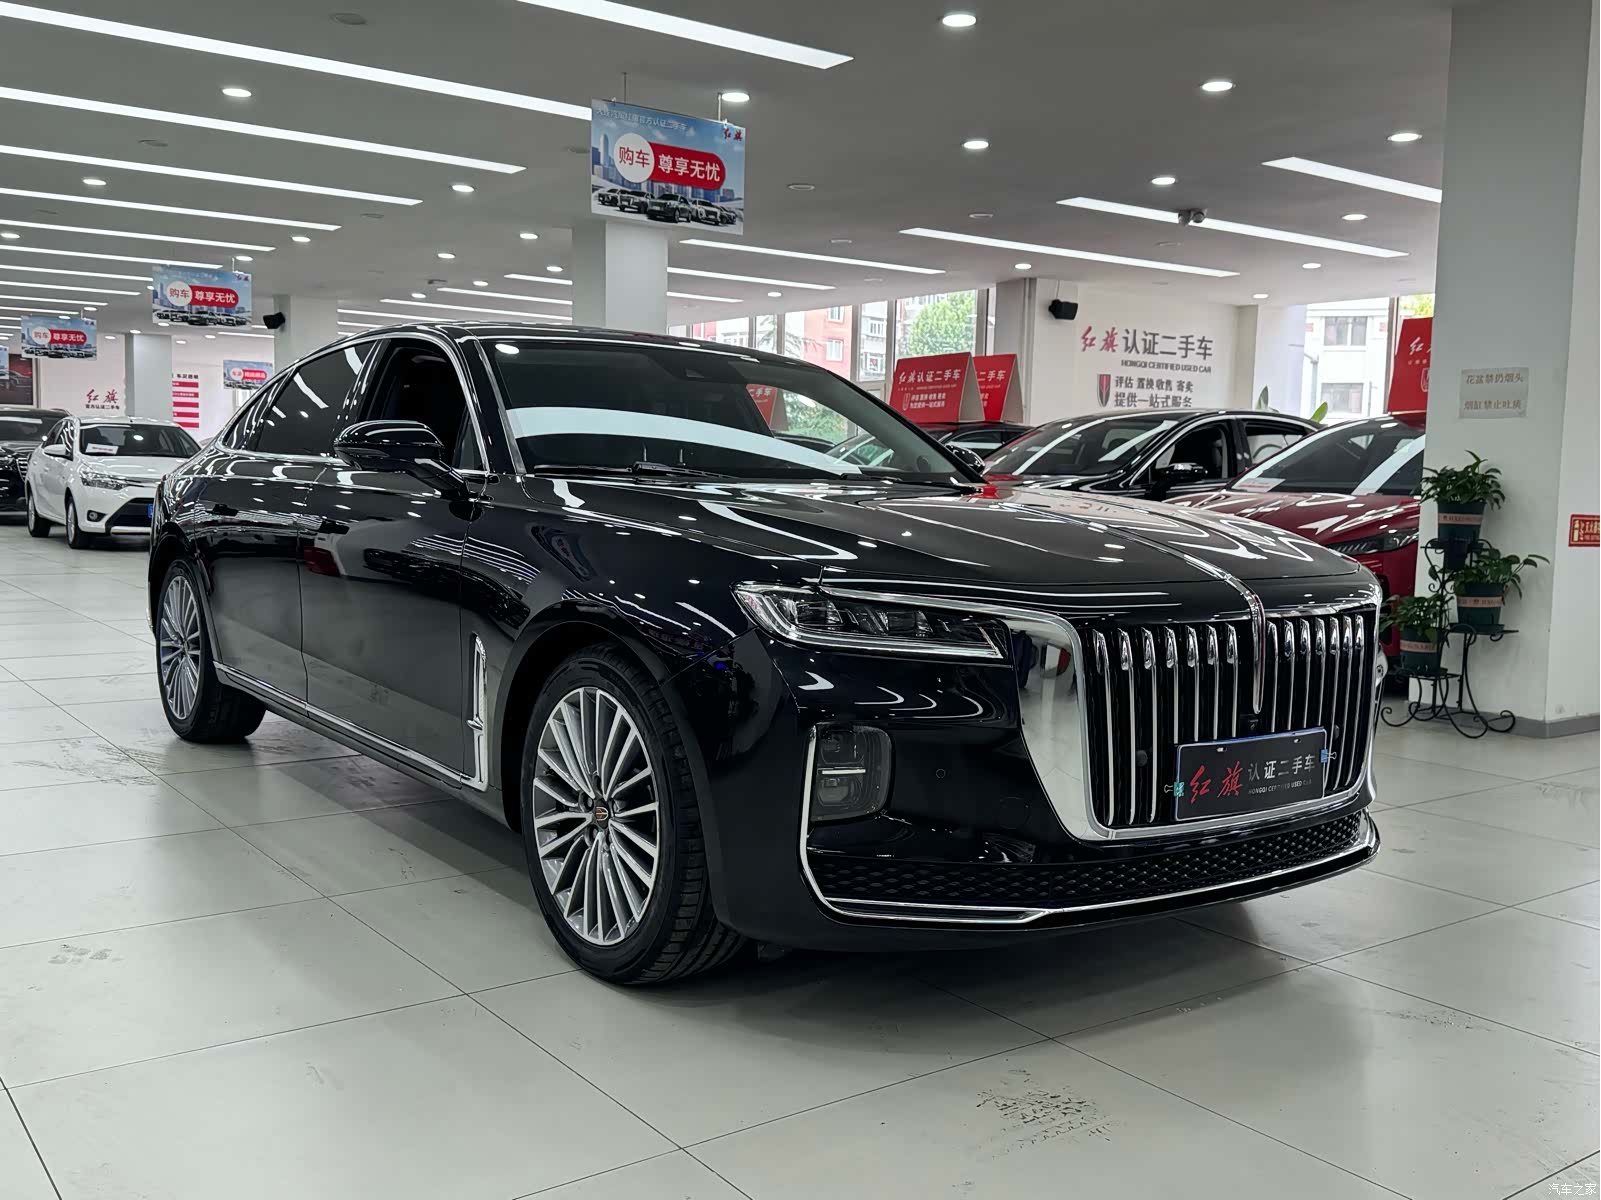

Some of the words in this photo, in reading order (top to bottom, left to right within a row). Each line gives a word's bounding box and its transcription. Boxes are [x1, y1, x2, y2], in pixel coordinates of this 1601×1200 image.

[618, 146, 650, 169] 购车
[658, 153, 721, 182] 尊享无忧
[169, 287, 190, 299] 购车
[194, 290, 236, 304] 尊享无忧
[1081, 325, 1213, 360] 红旗认证二手车
[899, 369, 961, 384] 红旗认证二手车
[1181, 363, 1198, 372] USED
[1199, 364, 1211, 374] CAR
[86, 388, 119, 403] 红旗
[1114, 391, 1192, 408] 提供一站式服务
[1190, 754, 1316, 804] 红旗认证二手车
[1291, 780, 1303, 788] USED
